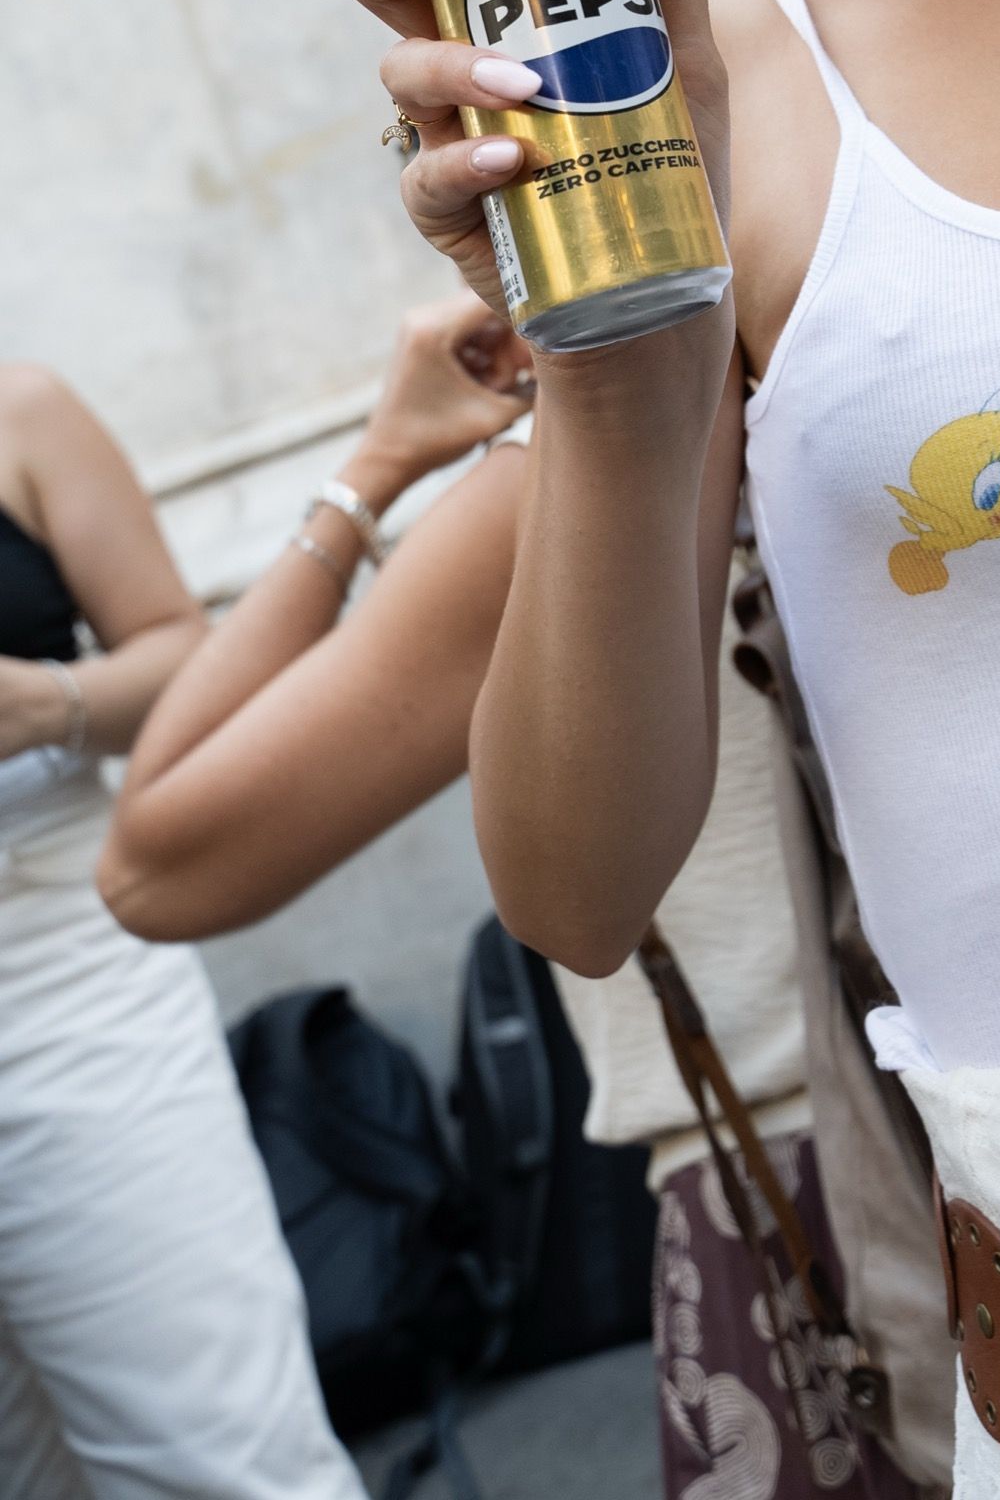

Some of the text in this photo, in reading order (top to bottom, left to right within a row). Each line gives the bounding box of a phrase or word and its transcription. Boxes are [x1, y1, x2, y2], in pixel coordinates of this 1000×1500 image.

[532, 139, 696, 183] ZERO ZUCCHERO
[536, 155, 701, 199] ZERO CAFFEINA
